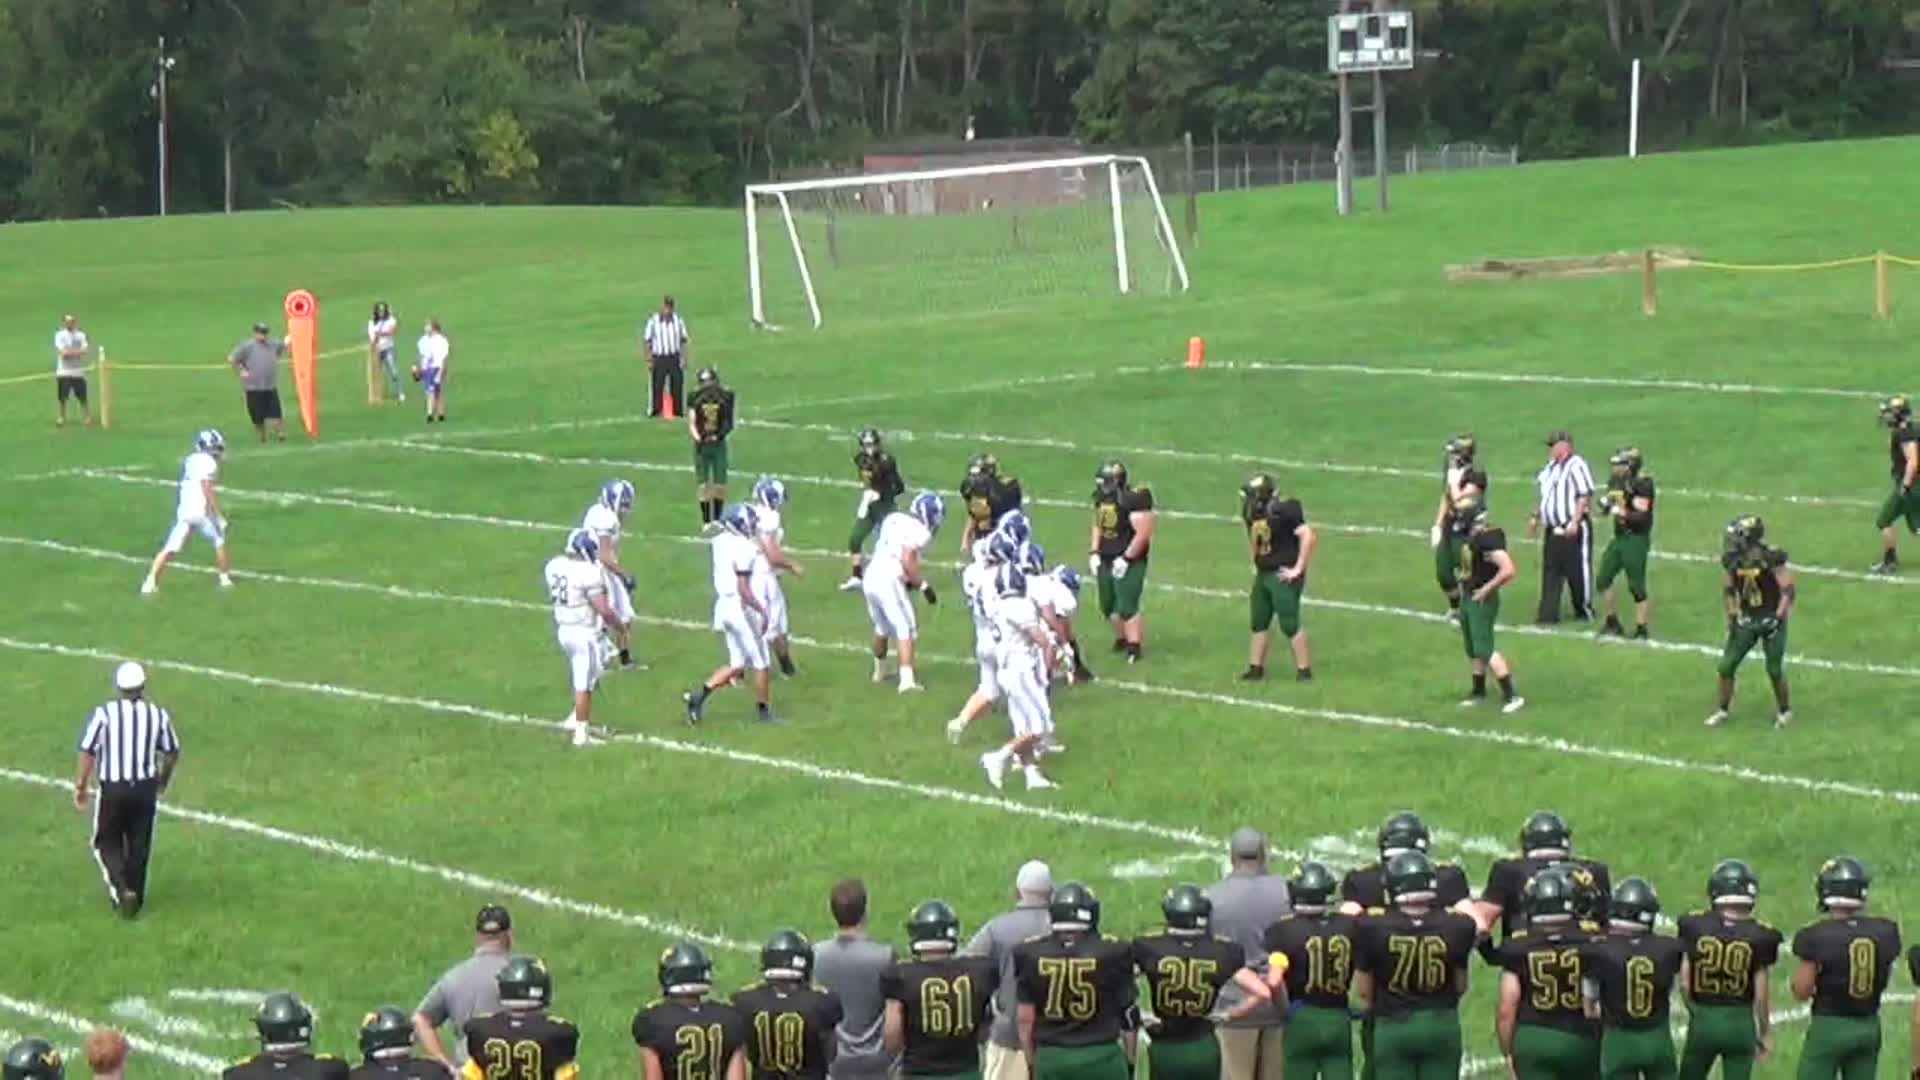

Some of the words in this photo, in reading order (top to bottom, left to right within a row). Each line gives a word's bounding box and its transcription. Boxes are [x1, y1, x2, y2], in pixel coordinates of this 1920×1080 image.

[1038, 957, 1097, 1019] 75
[1156, 955, 1217, 1016] 25
[1305, 935, 1350, 994] 13
[1388, 934, 1446, 993] 76
[1529, 948, 1583, 1010] 53
[1626, 956, 1654, 1018] 6
[1694, 936, 1753, 997] 29
[1849, 937, 1876, 998] 8
[921, 975, 973, 1036] 61
[484, 1039, 541, 1080] 23
[676, 1023, 723, 1080] 21
[754, 1011, 805, 1072] 18
